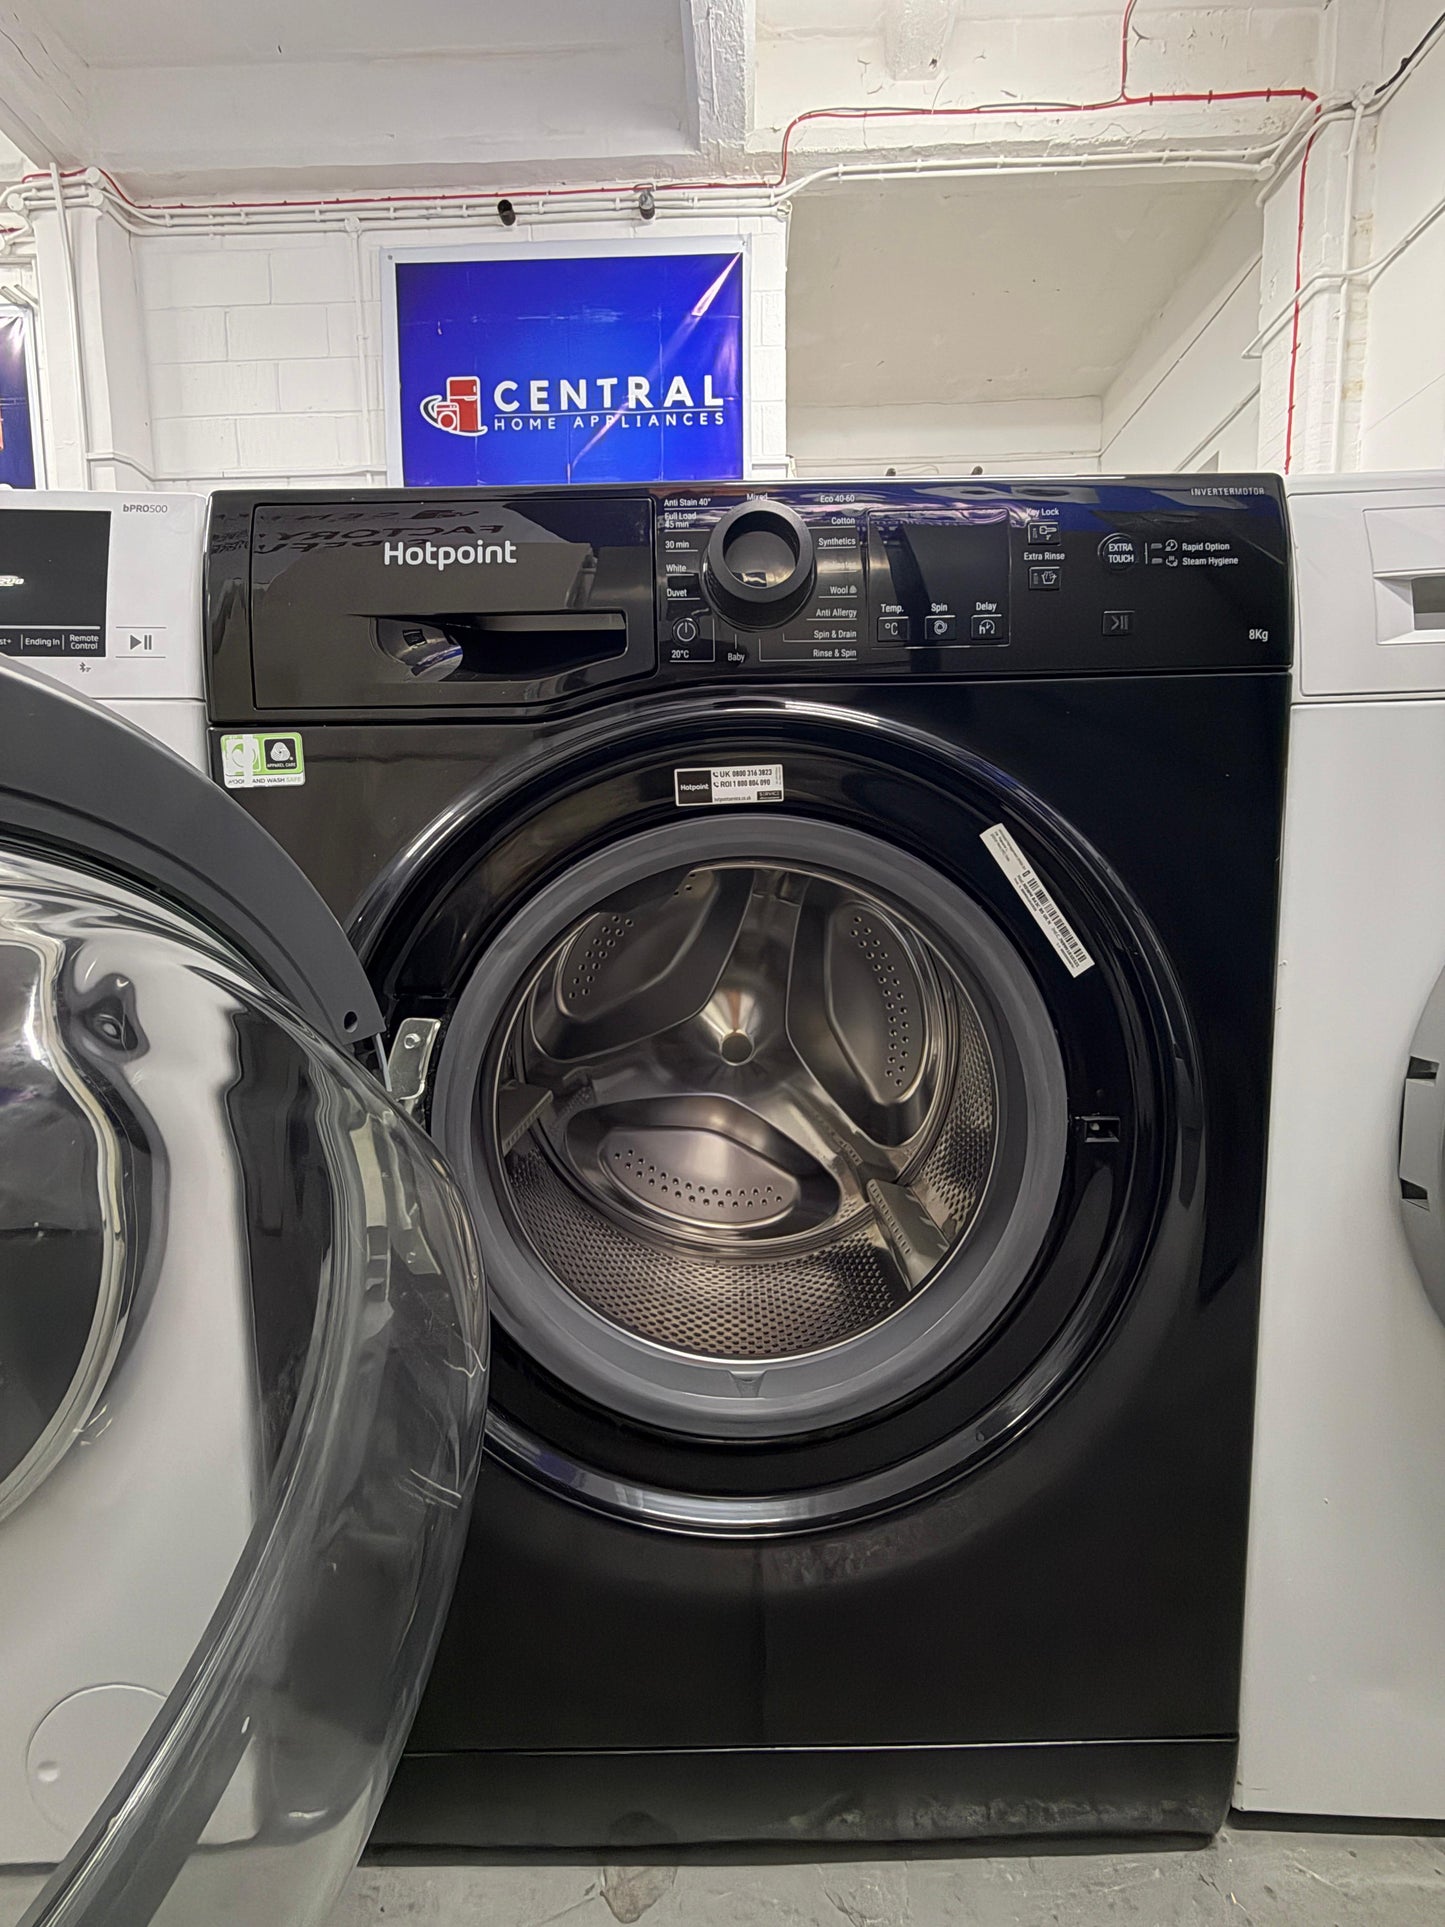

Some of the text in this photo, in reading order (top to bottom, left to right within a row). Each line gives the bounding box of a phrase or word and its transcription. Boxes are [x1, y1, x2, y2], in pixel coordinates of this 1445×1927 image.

[493, 374, 724, 412] CENTRAL
[494, 412, 724, 431] HOME APPLIANCES
[1190, 487, 1265, 496] INVERTERMOTOR
[664, 498, 678, 507] Anti
[679, 498, 698, 506] Stain
[820, 494, 855, 503] Eco 40-60
[123, 504, 168, 513] bPRO500
[1026, 508, 1060, 517] Key Lock
[664, 512, 697, 520] Full Load
[831, 516, 856, 525] Cotton
[664, 520, 689, 528] 45 min
[665, 540, 690, 549] 30 min
[818, 538, 856, 547] Synthetics
[1182, 540, 1230, 553] Rapid Option
[1108, 542, 1133, 553] EXTRA
[384, 540, 517, 571] Hotpoint
[1024, 552, 1065, 560] Extra Rinse
[1107, 554, 1134, 564] TOUCH
[1182, 555, 1239, 568] Steam Hygiene
[666, 564, 686, 572] White
[666, 588, 688, 597] Duvet
[830, 586, 848, 594] Wool
[880, 601, 997, 614] Temp. Spin Delay
[816, 608, 857, 619] Anti Allergy
[70, 634, 99, 642] Remote
[814, 630, 857, 640] Spin & Drain
[1248, 628, 1269, 642] 8Kg
[25, 638, 52, 647] Ending
[70, 642, 98, 650] Control
[672, 650, 690, 659] 20°C
[813, 648, 857, 658] Rinse & Spin
[727, 652, 745, 664] Baby
[680, 783, 710, 792] Hotpoint
